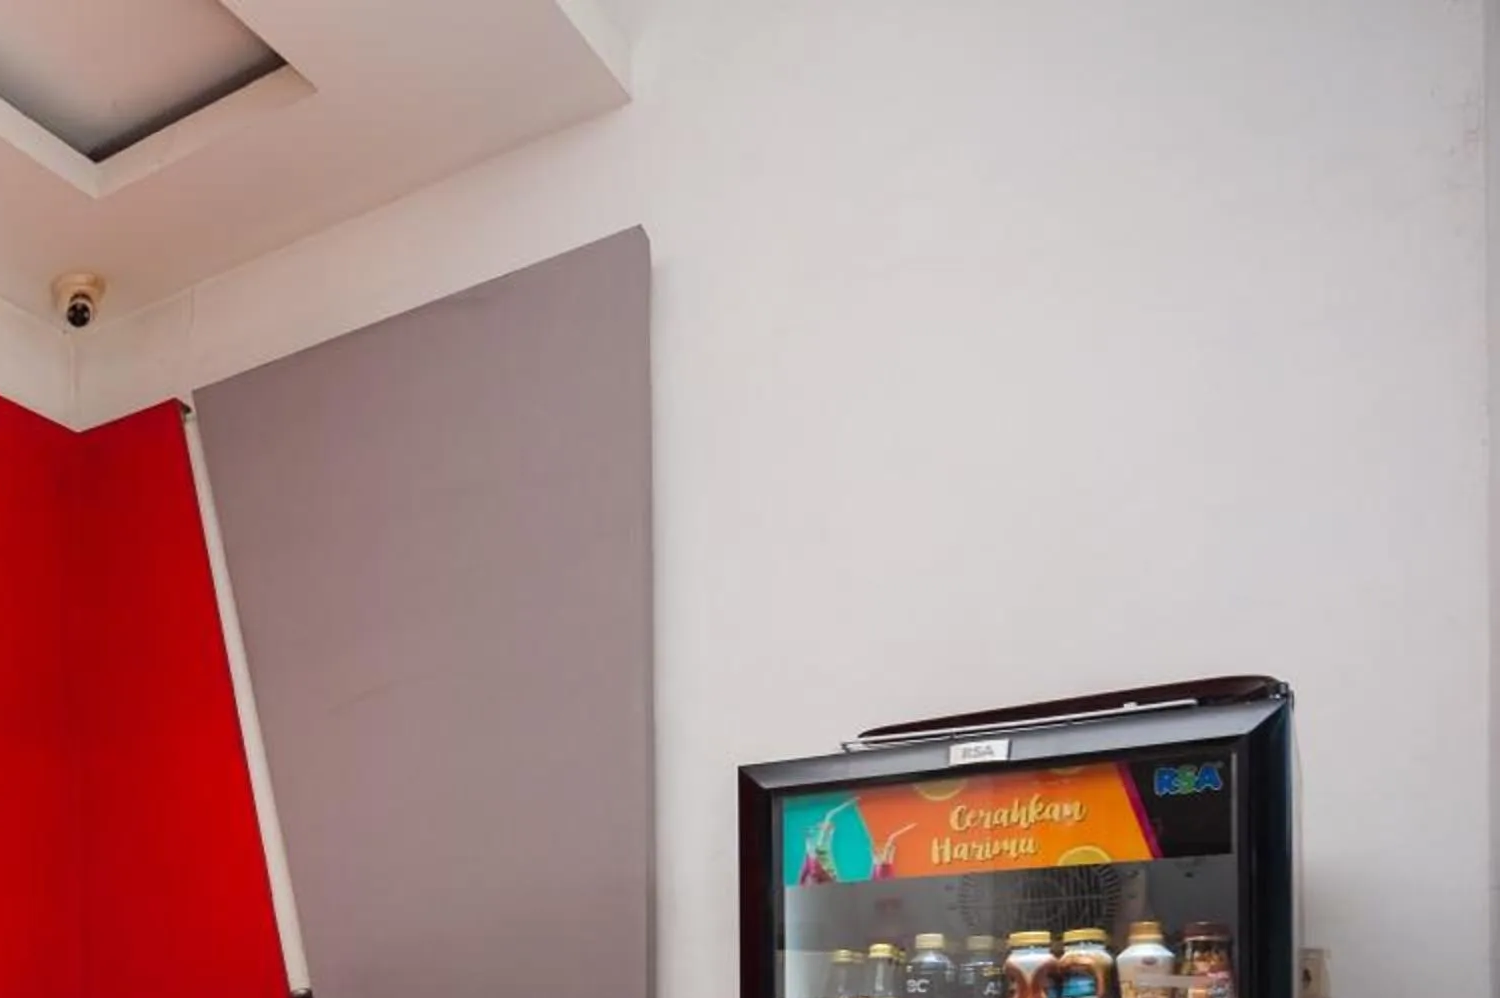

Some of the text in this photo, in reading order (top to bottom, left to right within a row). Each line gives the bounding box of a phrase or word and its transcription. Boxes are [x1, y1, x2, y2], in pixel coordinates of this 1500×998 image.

[1154, 763, 1224, 797] RSA
[949, 793, 1086, 832] Cerahkan
[931, 836, 1038, 865] Harimu
